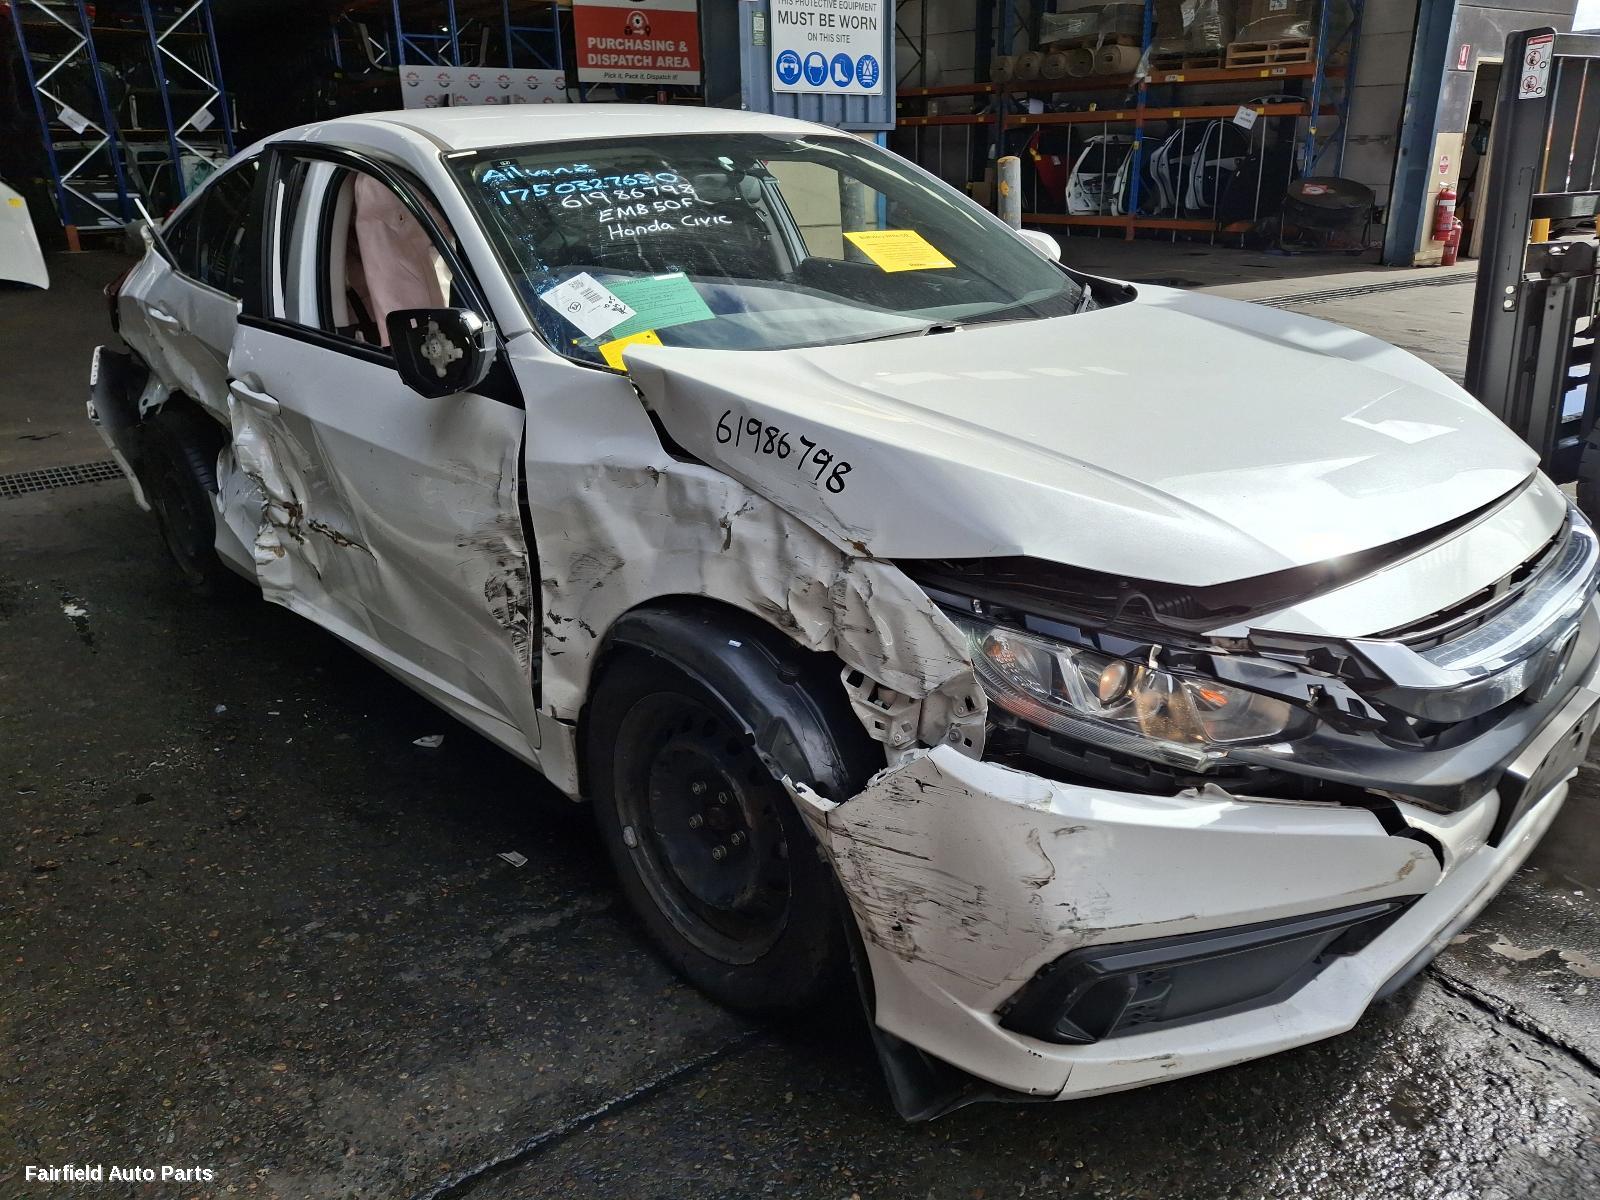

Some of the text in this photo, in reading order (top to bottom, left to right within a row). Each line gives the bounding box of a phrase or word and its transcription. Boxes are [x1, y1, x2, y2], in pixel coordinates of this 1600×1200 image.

[795, 0, 837, 8] PROTECTIVE
[839, 1, 877, 12] EQUIPMENT
[778, 10, 877, 30] MUST BE WORN
[587, 37, 688, 52] PURCHASING &
[807, 32, 851, 43] ON THIS SITE
[587, 53, 690, 68] DISPATCH AREA
[604, 71, 616, 79] Pick
[607, 219, 676, 240] Honda
[716, 409, 852, 494] 61986798
